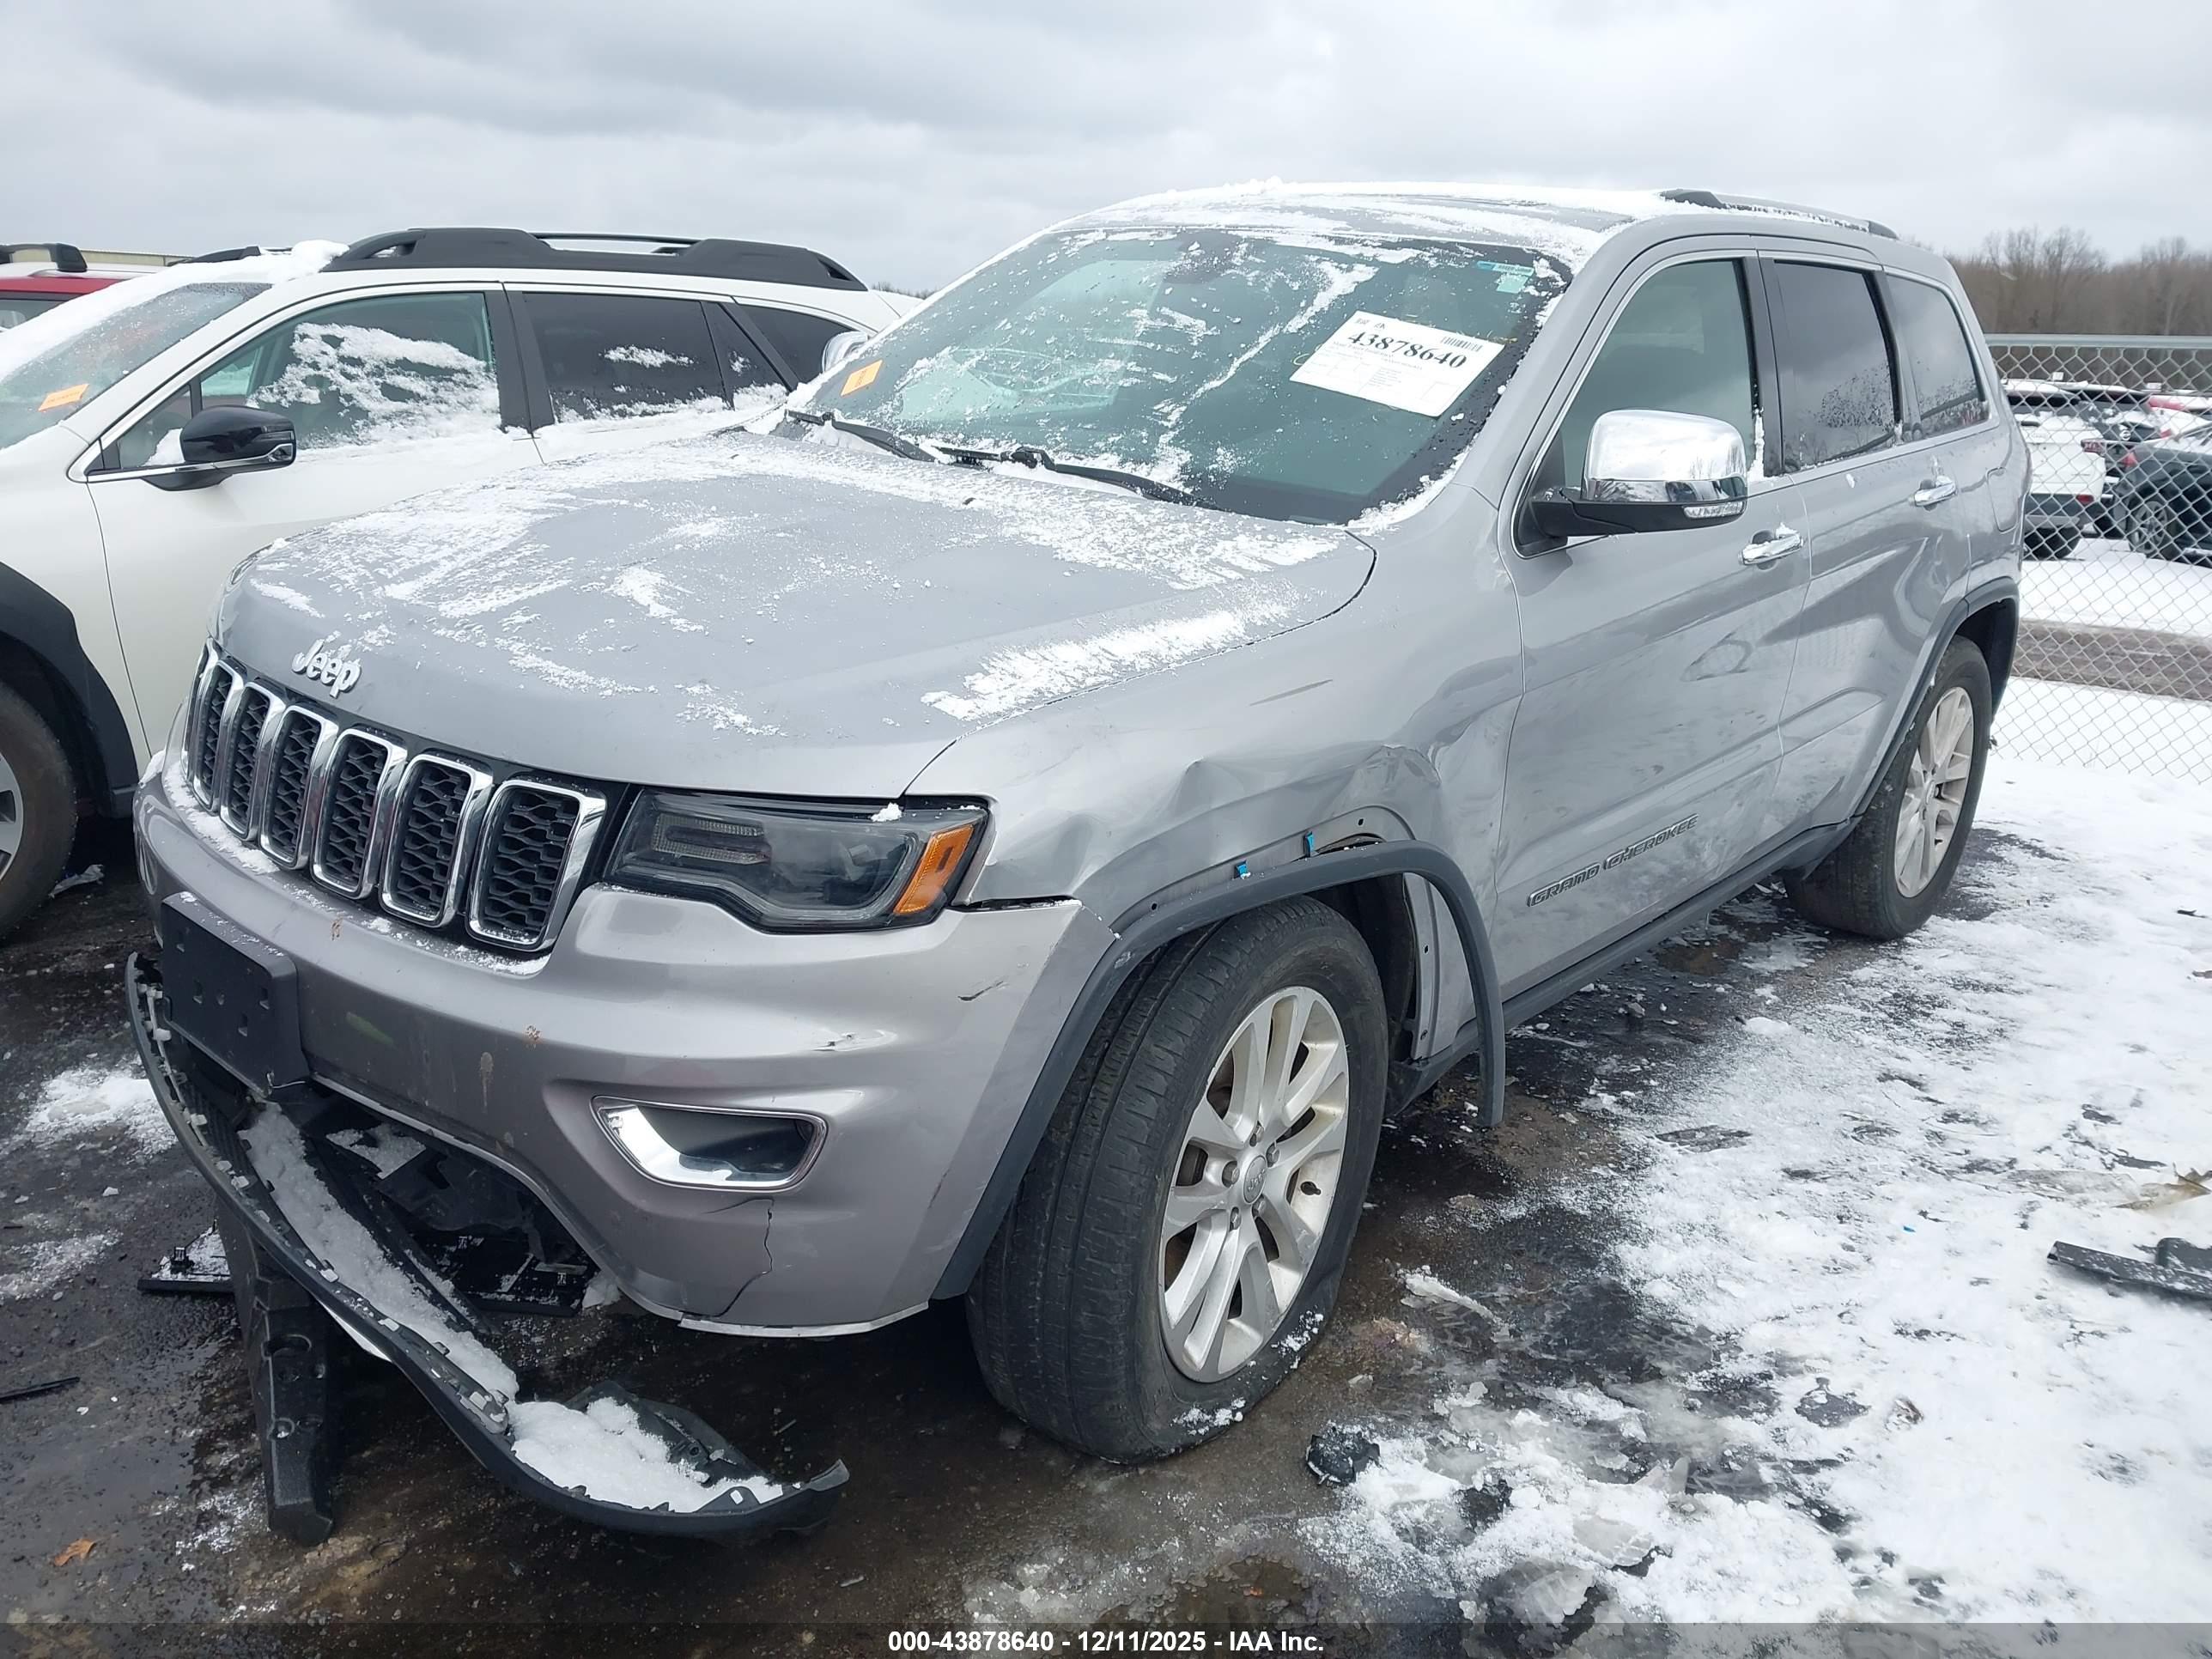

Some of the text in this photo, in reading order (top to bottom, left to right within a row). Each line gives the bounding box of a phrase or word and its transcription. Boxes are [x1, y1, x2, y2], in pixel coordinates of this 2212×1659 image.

[1348, 331, 1468, 368] 43878640
[292, 639, 362, 698] Jeep
[1528, 813, 1699, 907] GRAND CHEROKEE
